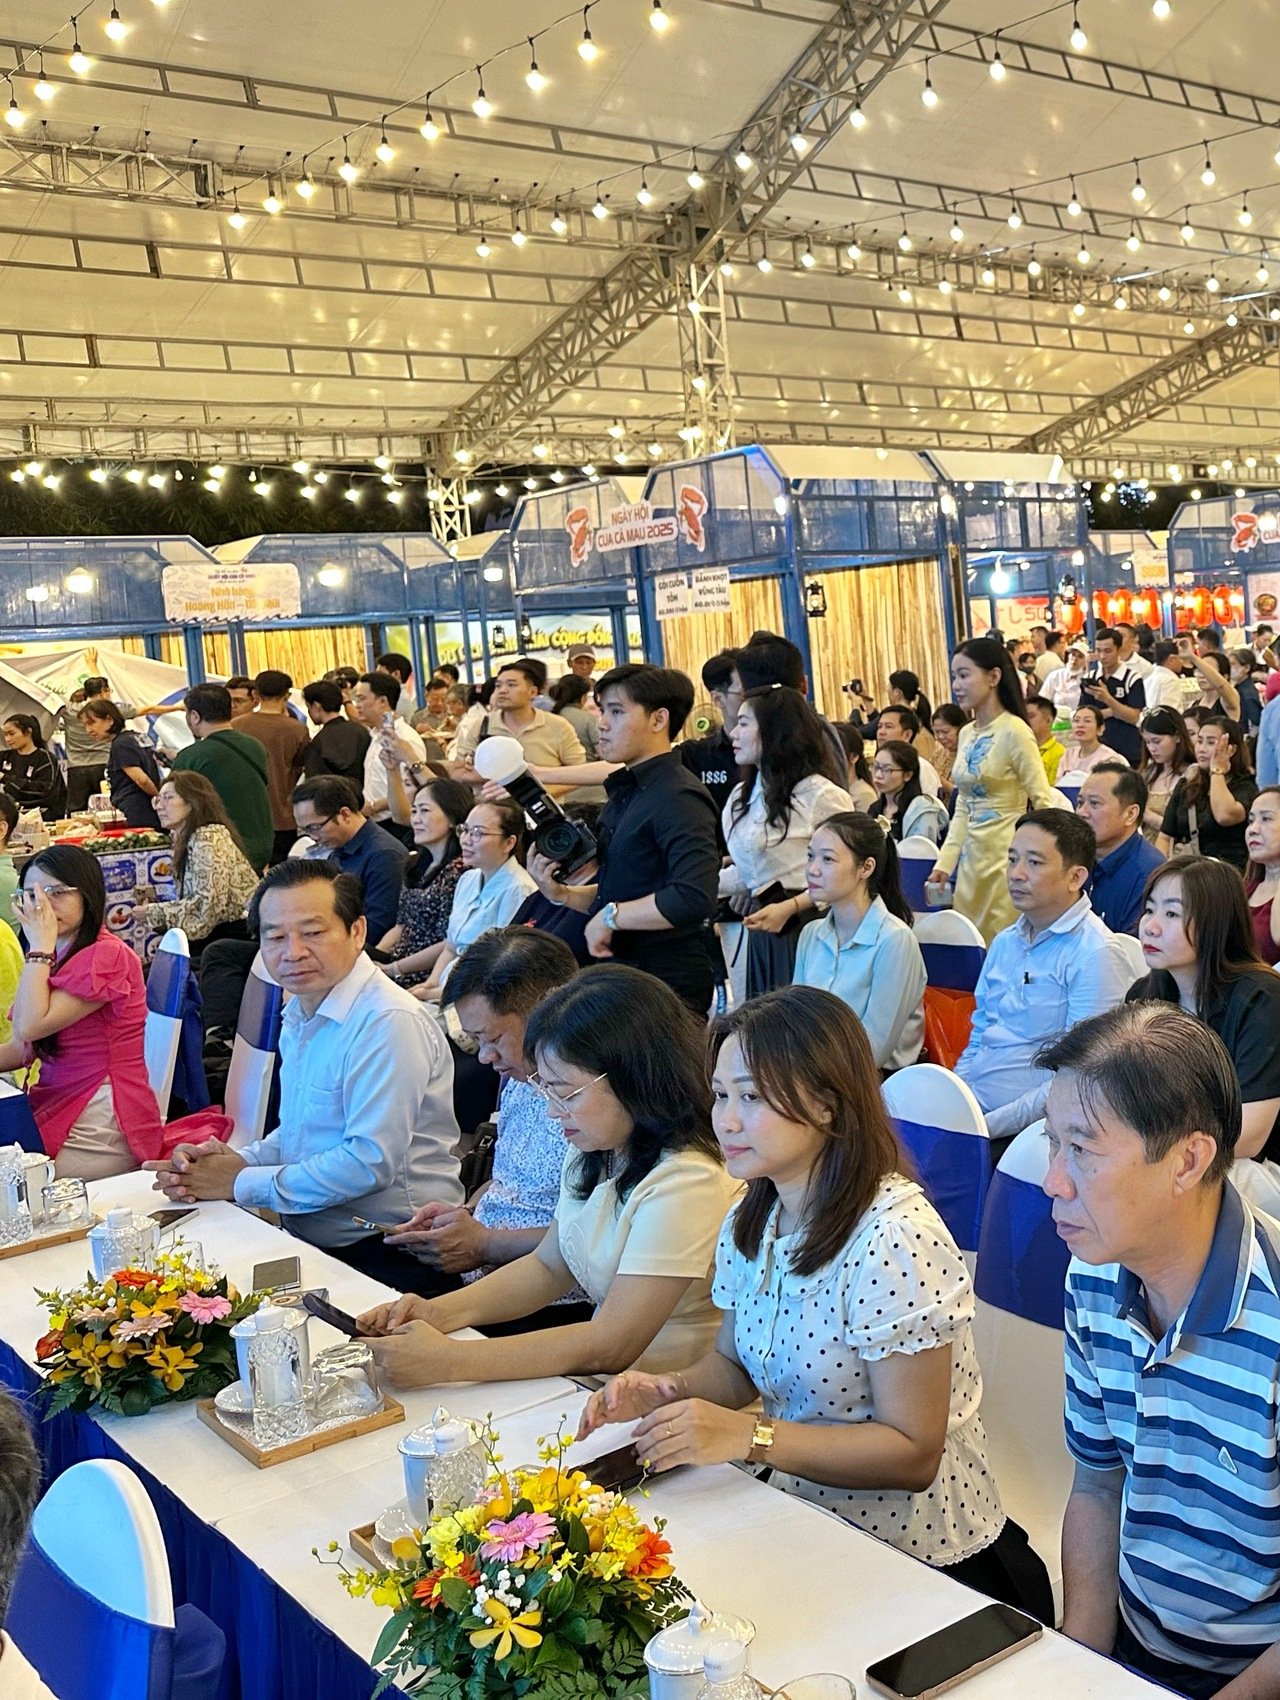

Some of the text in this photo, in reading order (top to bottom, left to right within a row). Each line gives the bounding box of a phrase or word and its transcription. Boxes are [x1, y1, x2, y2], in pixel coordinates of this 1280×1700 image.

[612, 506, 650, 525] NGÀY HỘI
[599, 522, 674, 547] CUA CÀ MAU 2025
[1263, 530, 1280, 541] CUA
[586, 622, 613, 646] ĐỒN
[1115, 686, 1125, 698] B
[701, 770, 727, 785] 1886
